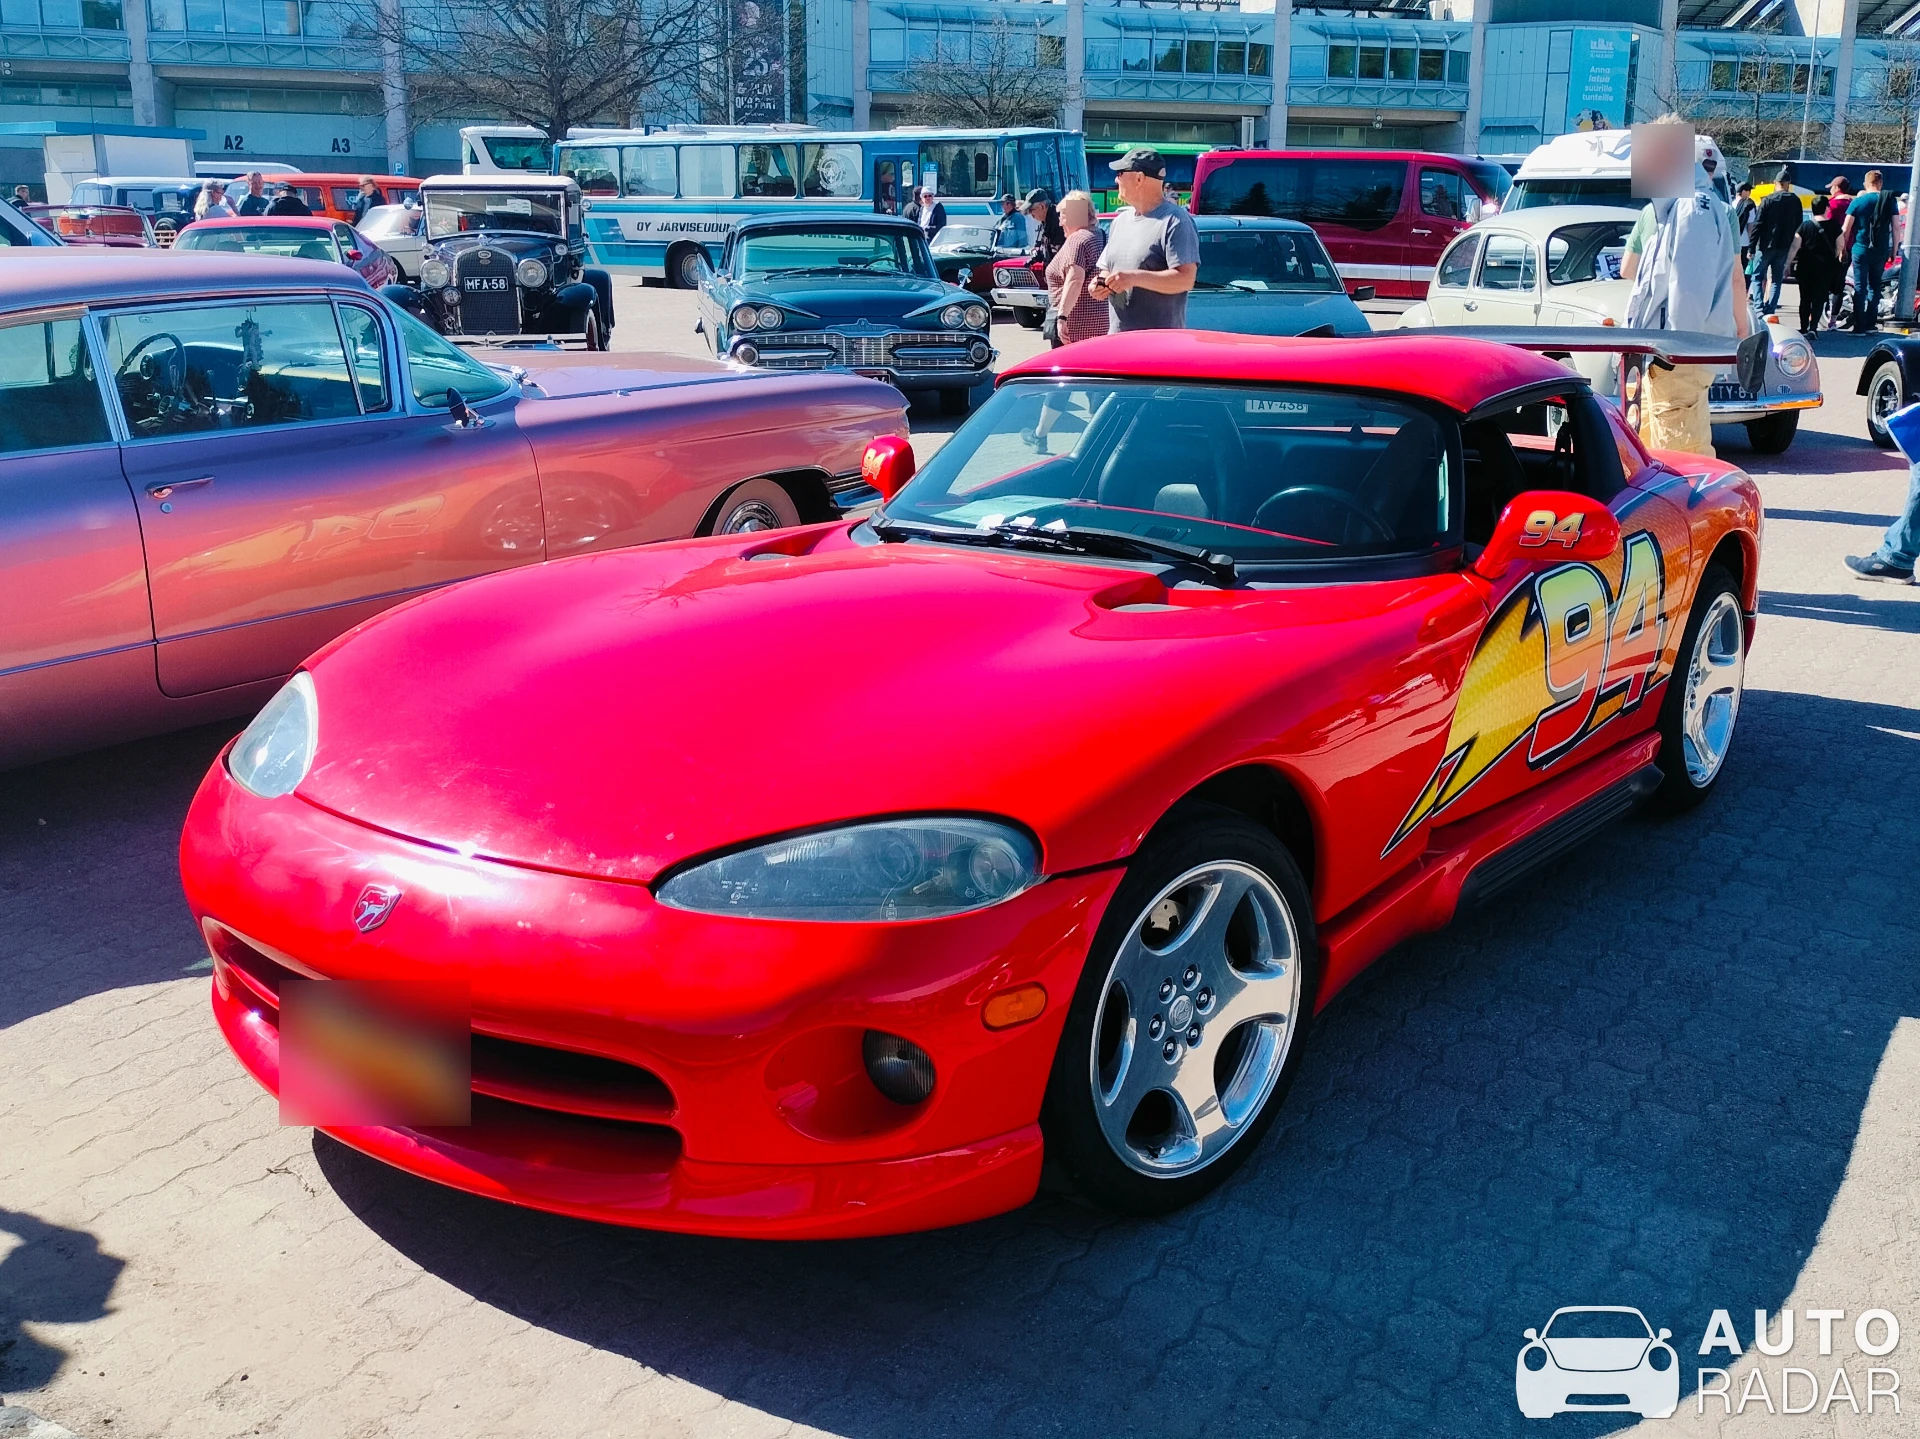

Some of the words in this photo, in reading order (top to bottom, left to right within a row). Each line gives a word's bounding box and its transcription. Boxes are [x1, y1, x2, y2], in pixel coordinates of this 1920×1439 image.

[1590, 66, 1611, 74] Anna
[1585, 84, 1613, 92] suurille
[1582, 93, 1614, 102] tunteille
[1102, 122, 1111, 137] A
[1191, 125, 1199, 138] A
[223, 134, 244, 150] A2
[331, 137, 351, 153] A3
[636, 221, 652, 232] OY
[1518, 509, 1586, 548] 94
[1526, 528, 1668, 771] 94
